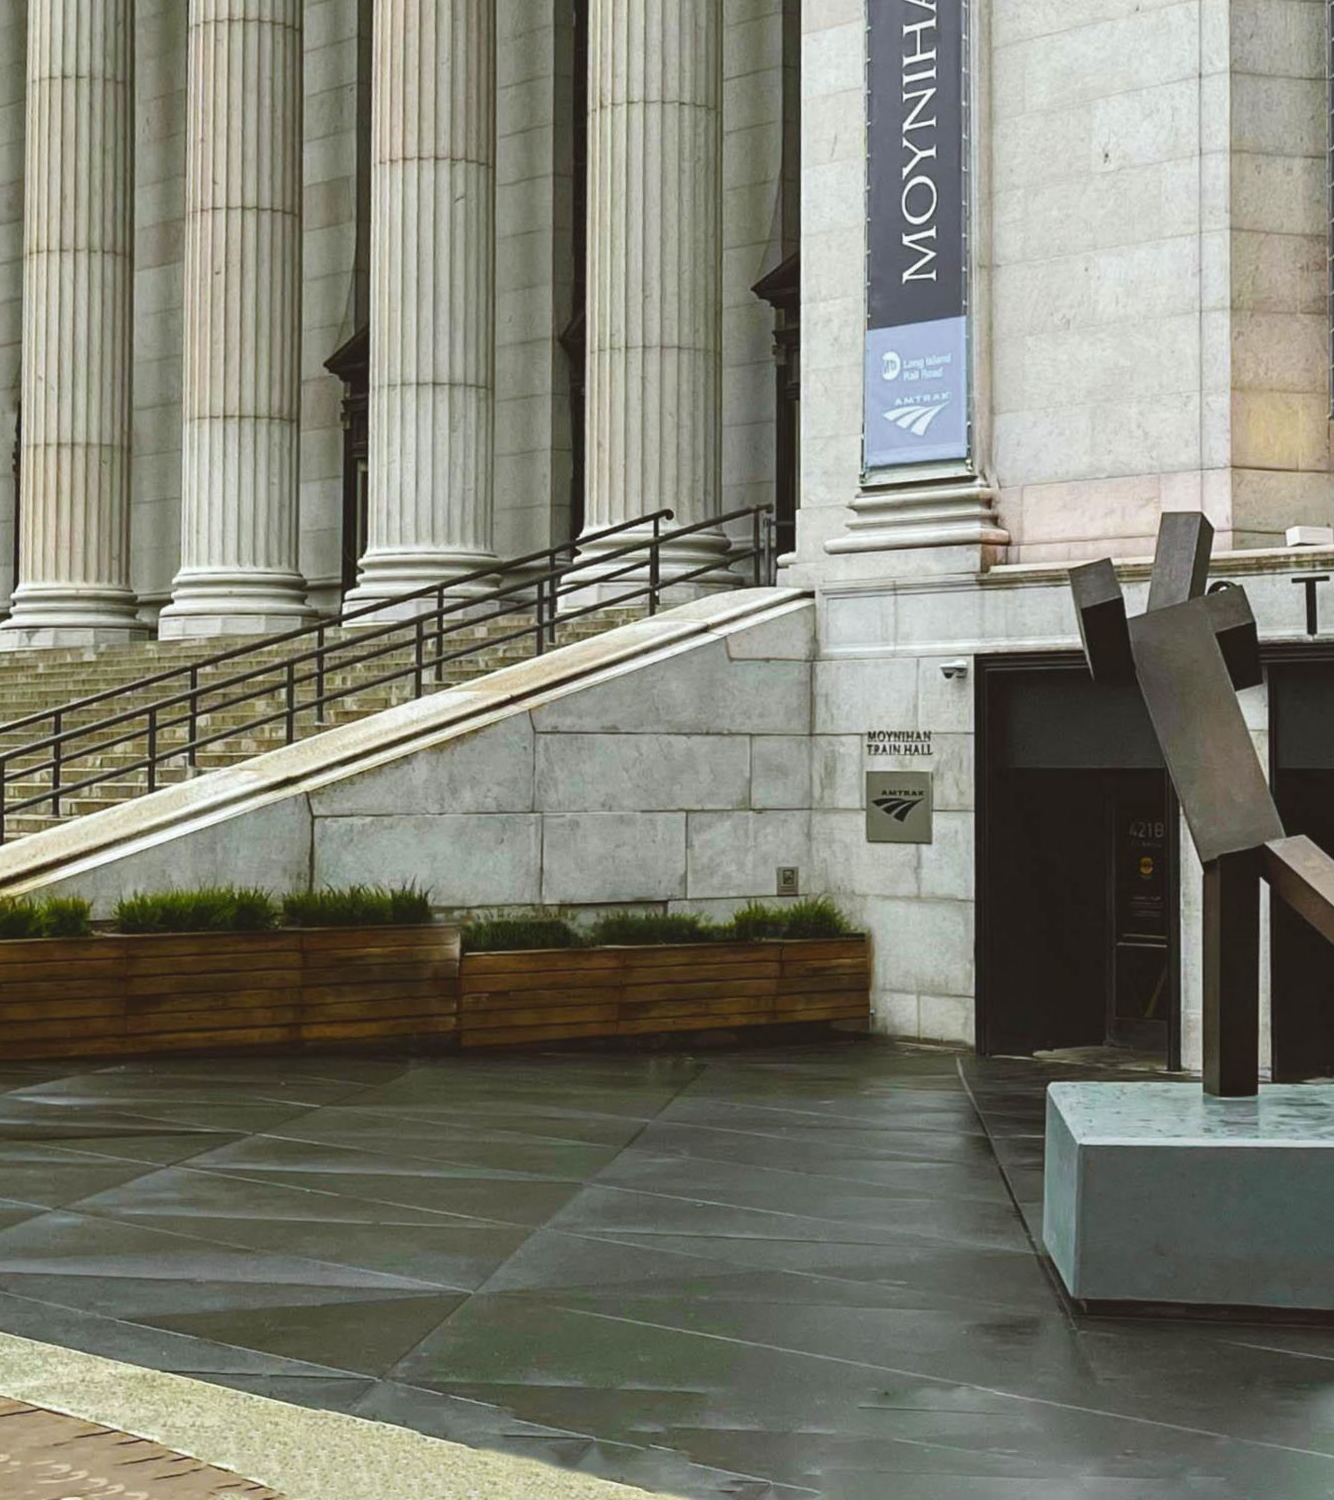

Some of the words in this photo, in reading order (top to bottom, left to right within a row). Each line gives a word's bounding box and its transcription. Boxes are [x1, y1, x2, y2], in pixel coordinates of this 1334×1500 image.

[867, 731, 932, 743] MOYNIHAN
[867, 744, 901, 756] TRAIN
[903, 744, 933, 756] HALL
